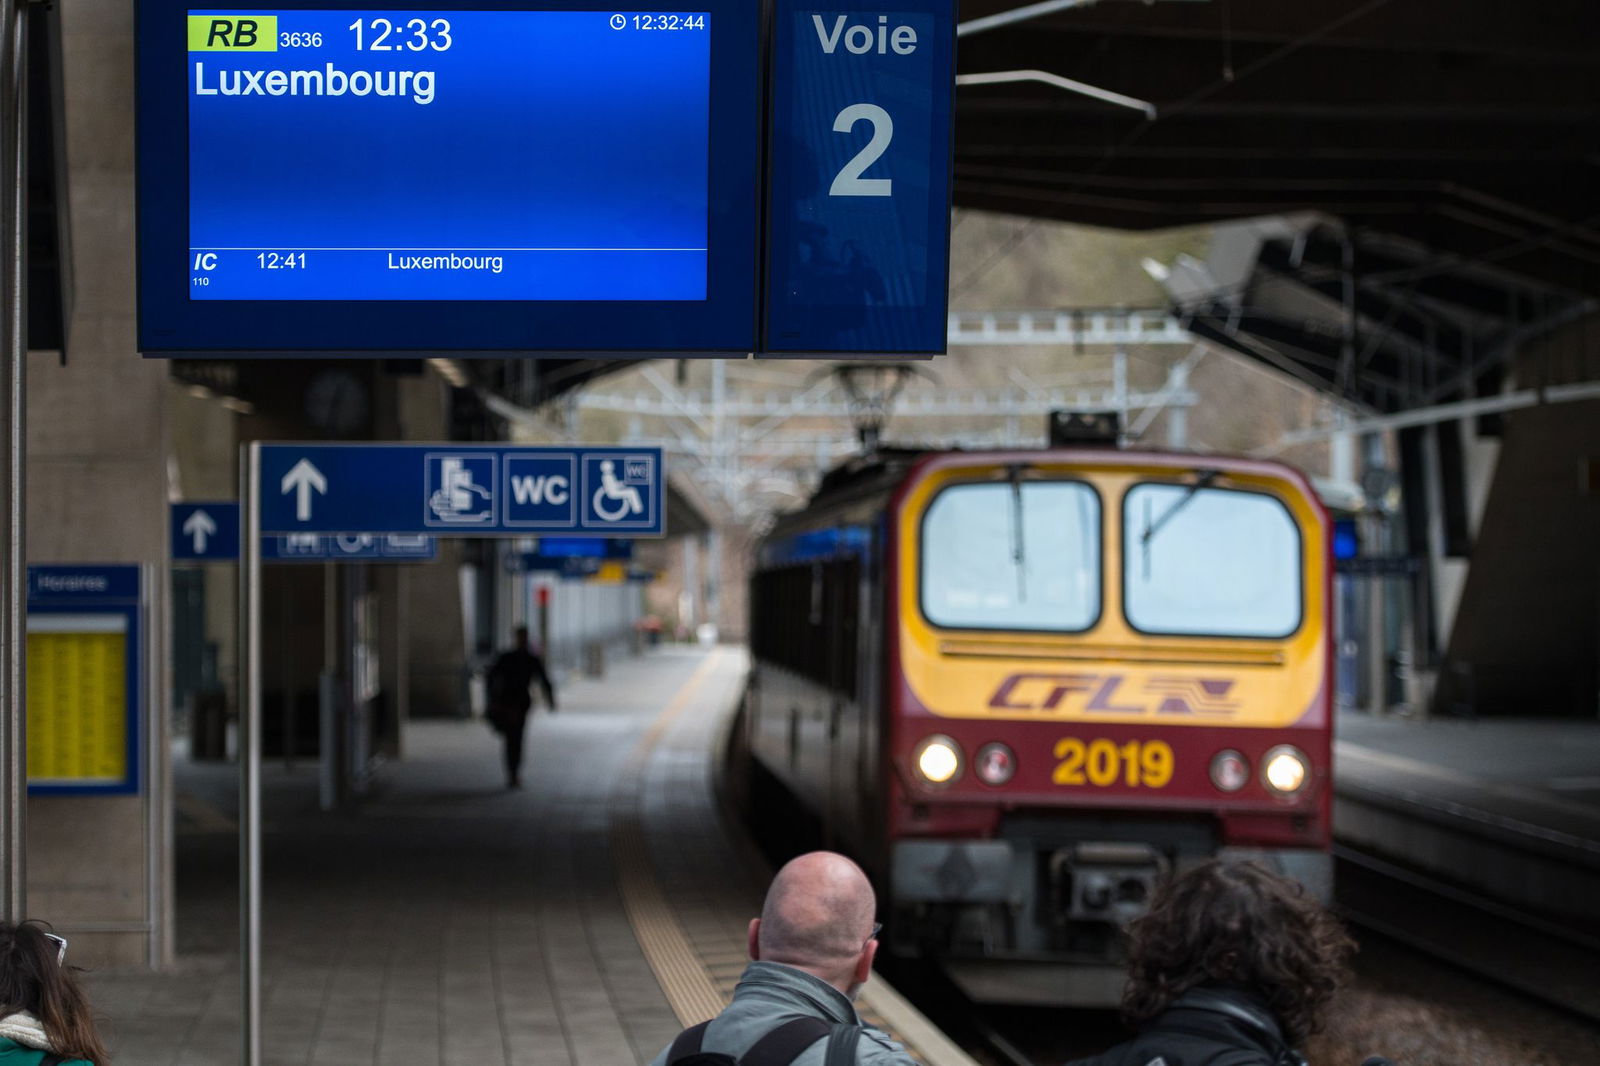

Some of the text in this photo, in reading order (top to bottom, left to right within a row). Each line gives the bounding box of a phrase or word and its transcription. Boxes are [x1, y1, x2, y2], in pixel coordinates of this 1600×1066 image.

[206, 18, 453, 52] RB 3636 12:33
[632, 14, 705, 31] 12:32:44
[812, 14, 918, 55] Voie
[195, 62, 436, 105] Luxembourg
[828, 103, 894, 197] 2
[192, 276, 210, 286] 110
[194, 252, 504, 274] IC 12:41 Luxembourg
[511, 475, 569, 505] WC
[988, 673, 1146, 712] CFL
[1053, 738, 1174, 787] 2019
